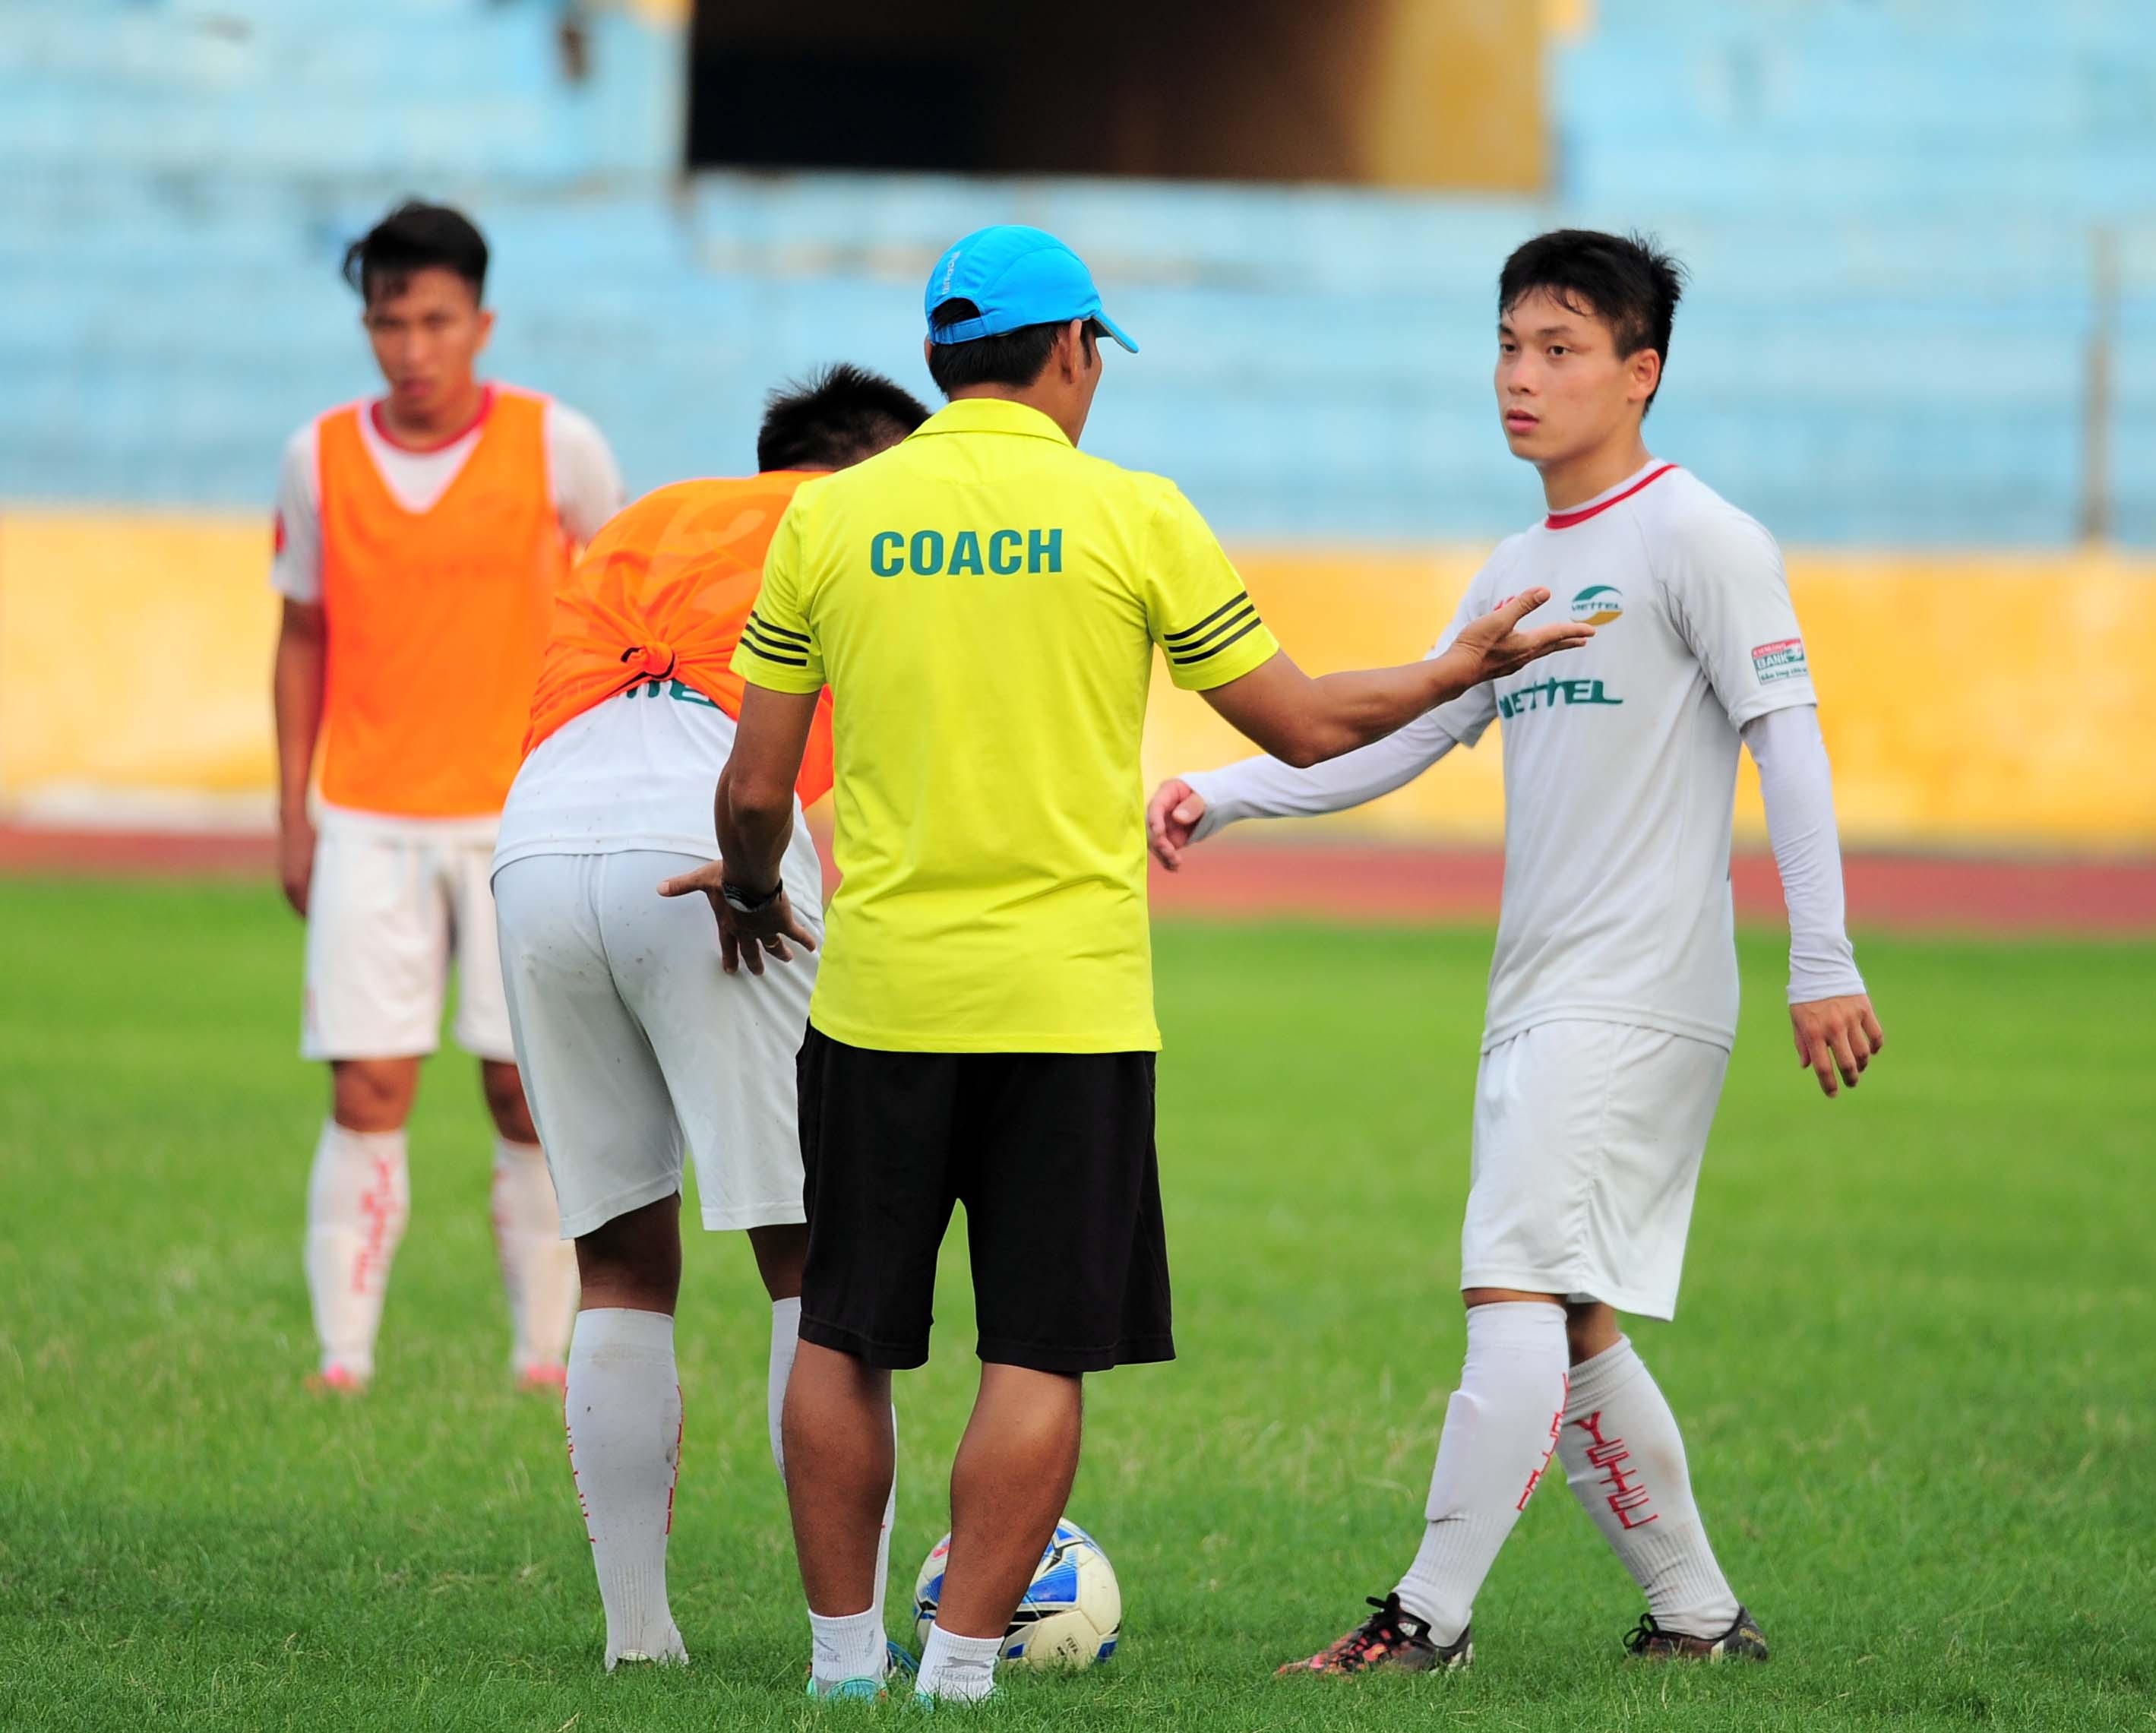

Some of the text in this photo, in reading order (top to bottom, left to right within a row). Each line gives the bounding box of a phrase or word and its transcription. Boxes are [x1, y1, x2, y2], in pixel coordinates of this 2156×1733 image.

[871, 529, 1063, 577] COACH
[1757, 651, 1788, 669] BANK
[1065, 1637, 1078, 1655] FIFA
